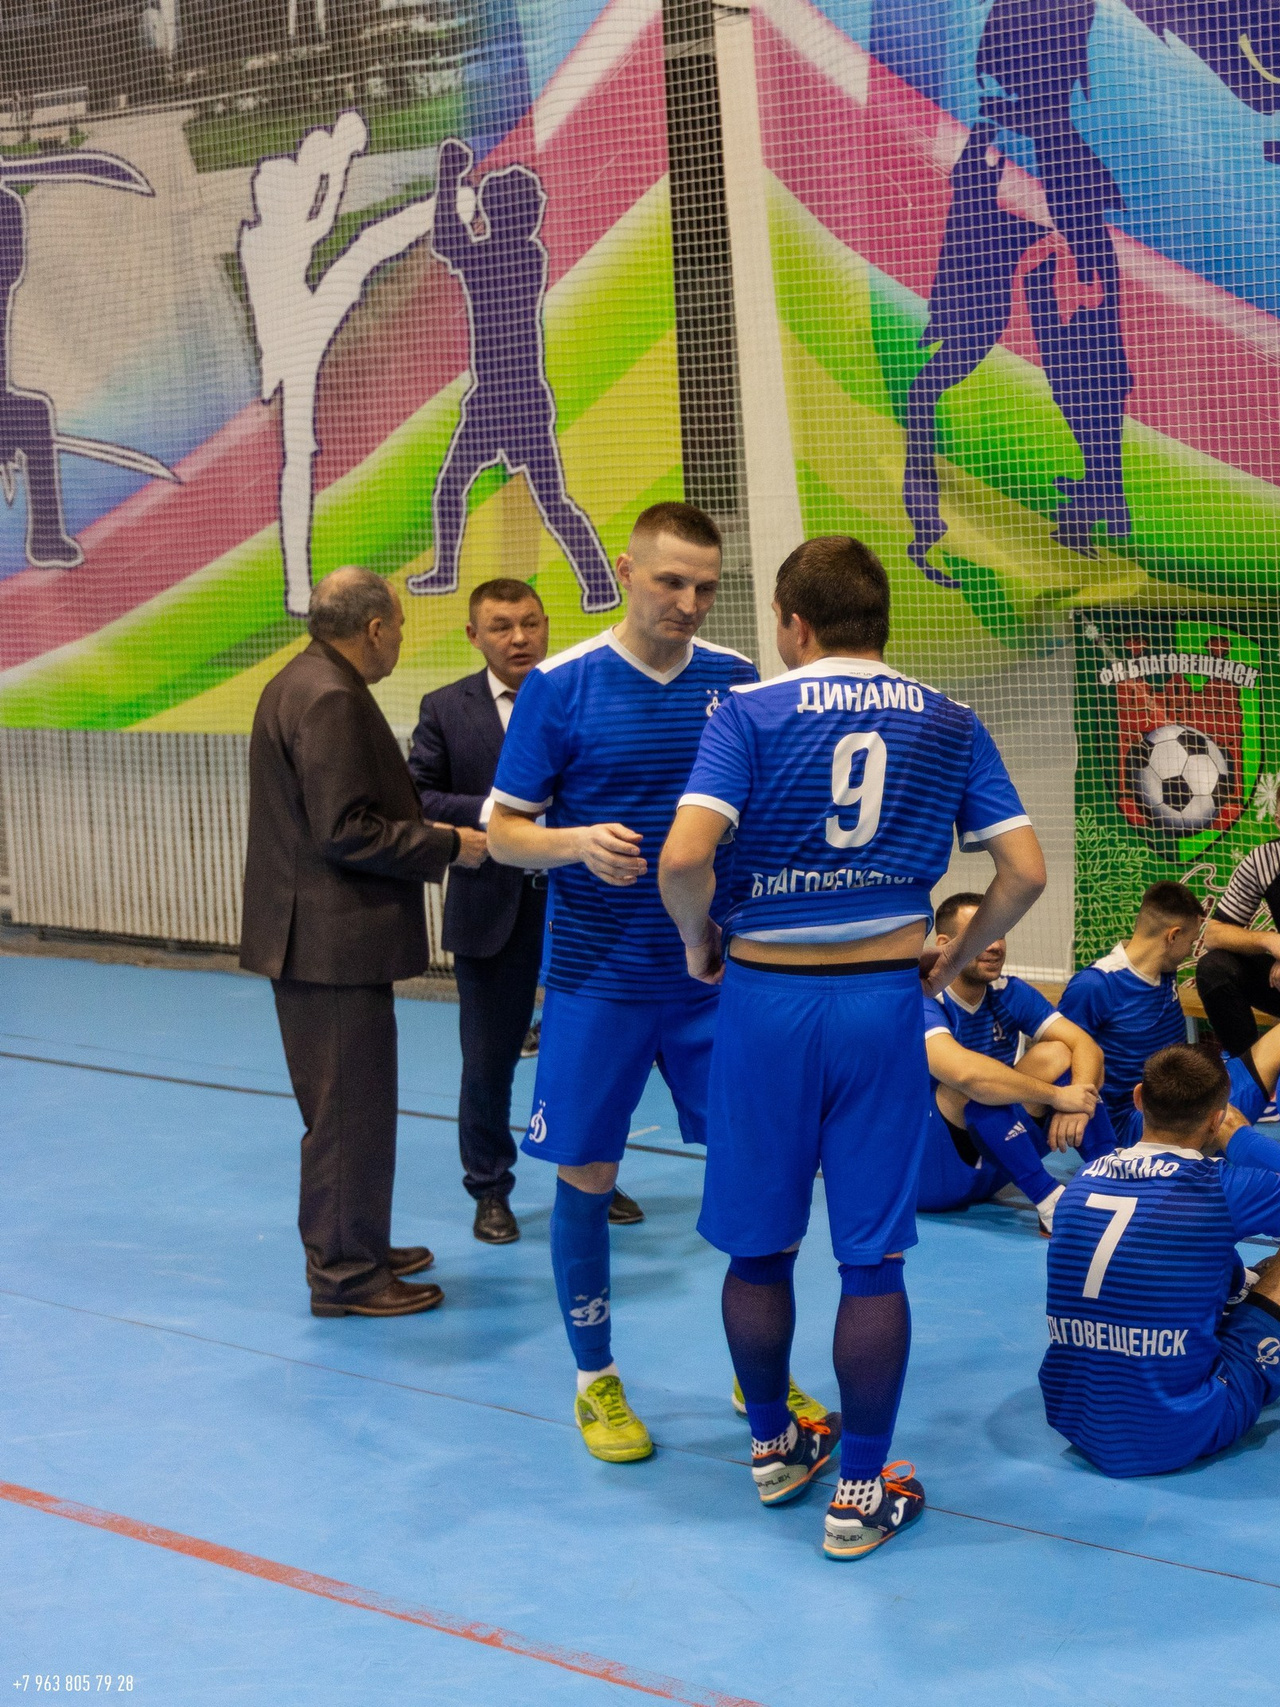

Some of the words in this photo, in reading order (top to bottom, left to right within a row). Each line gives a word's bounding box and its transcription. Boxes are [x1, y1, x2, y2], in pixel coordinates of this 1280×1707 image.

[797, 681, 924, 714] ДИНАМО
[1100, 661, 1125, 687] ФК
[1127, 653, 1260, 689] БЛАГОВЕЩЕНСК
[825, 732, 888, 849] 9
[1082, 1192, 1139, 1300] 7
